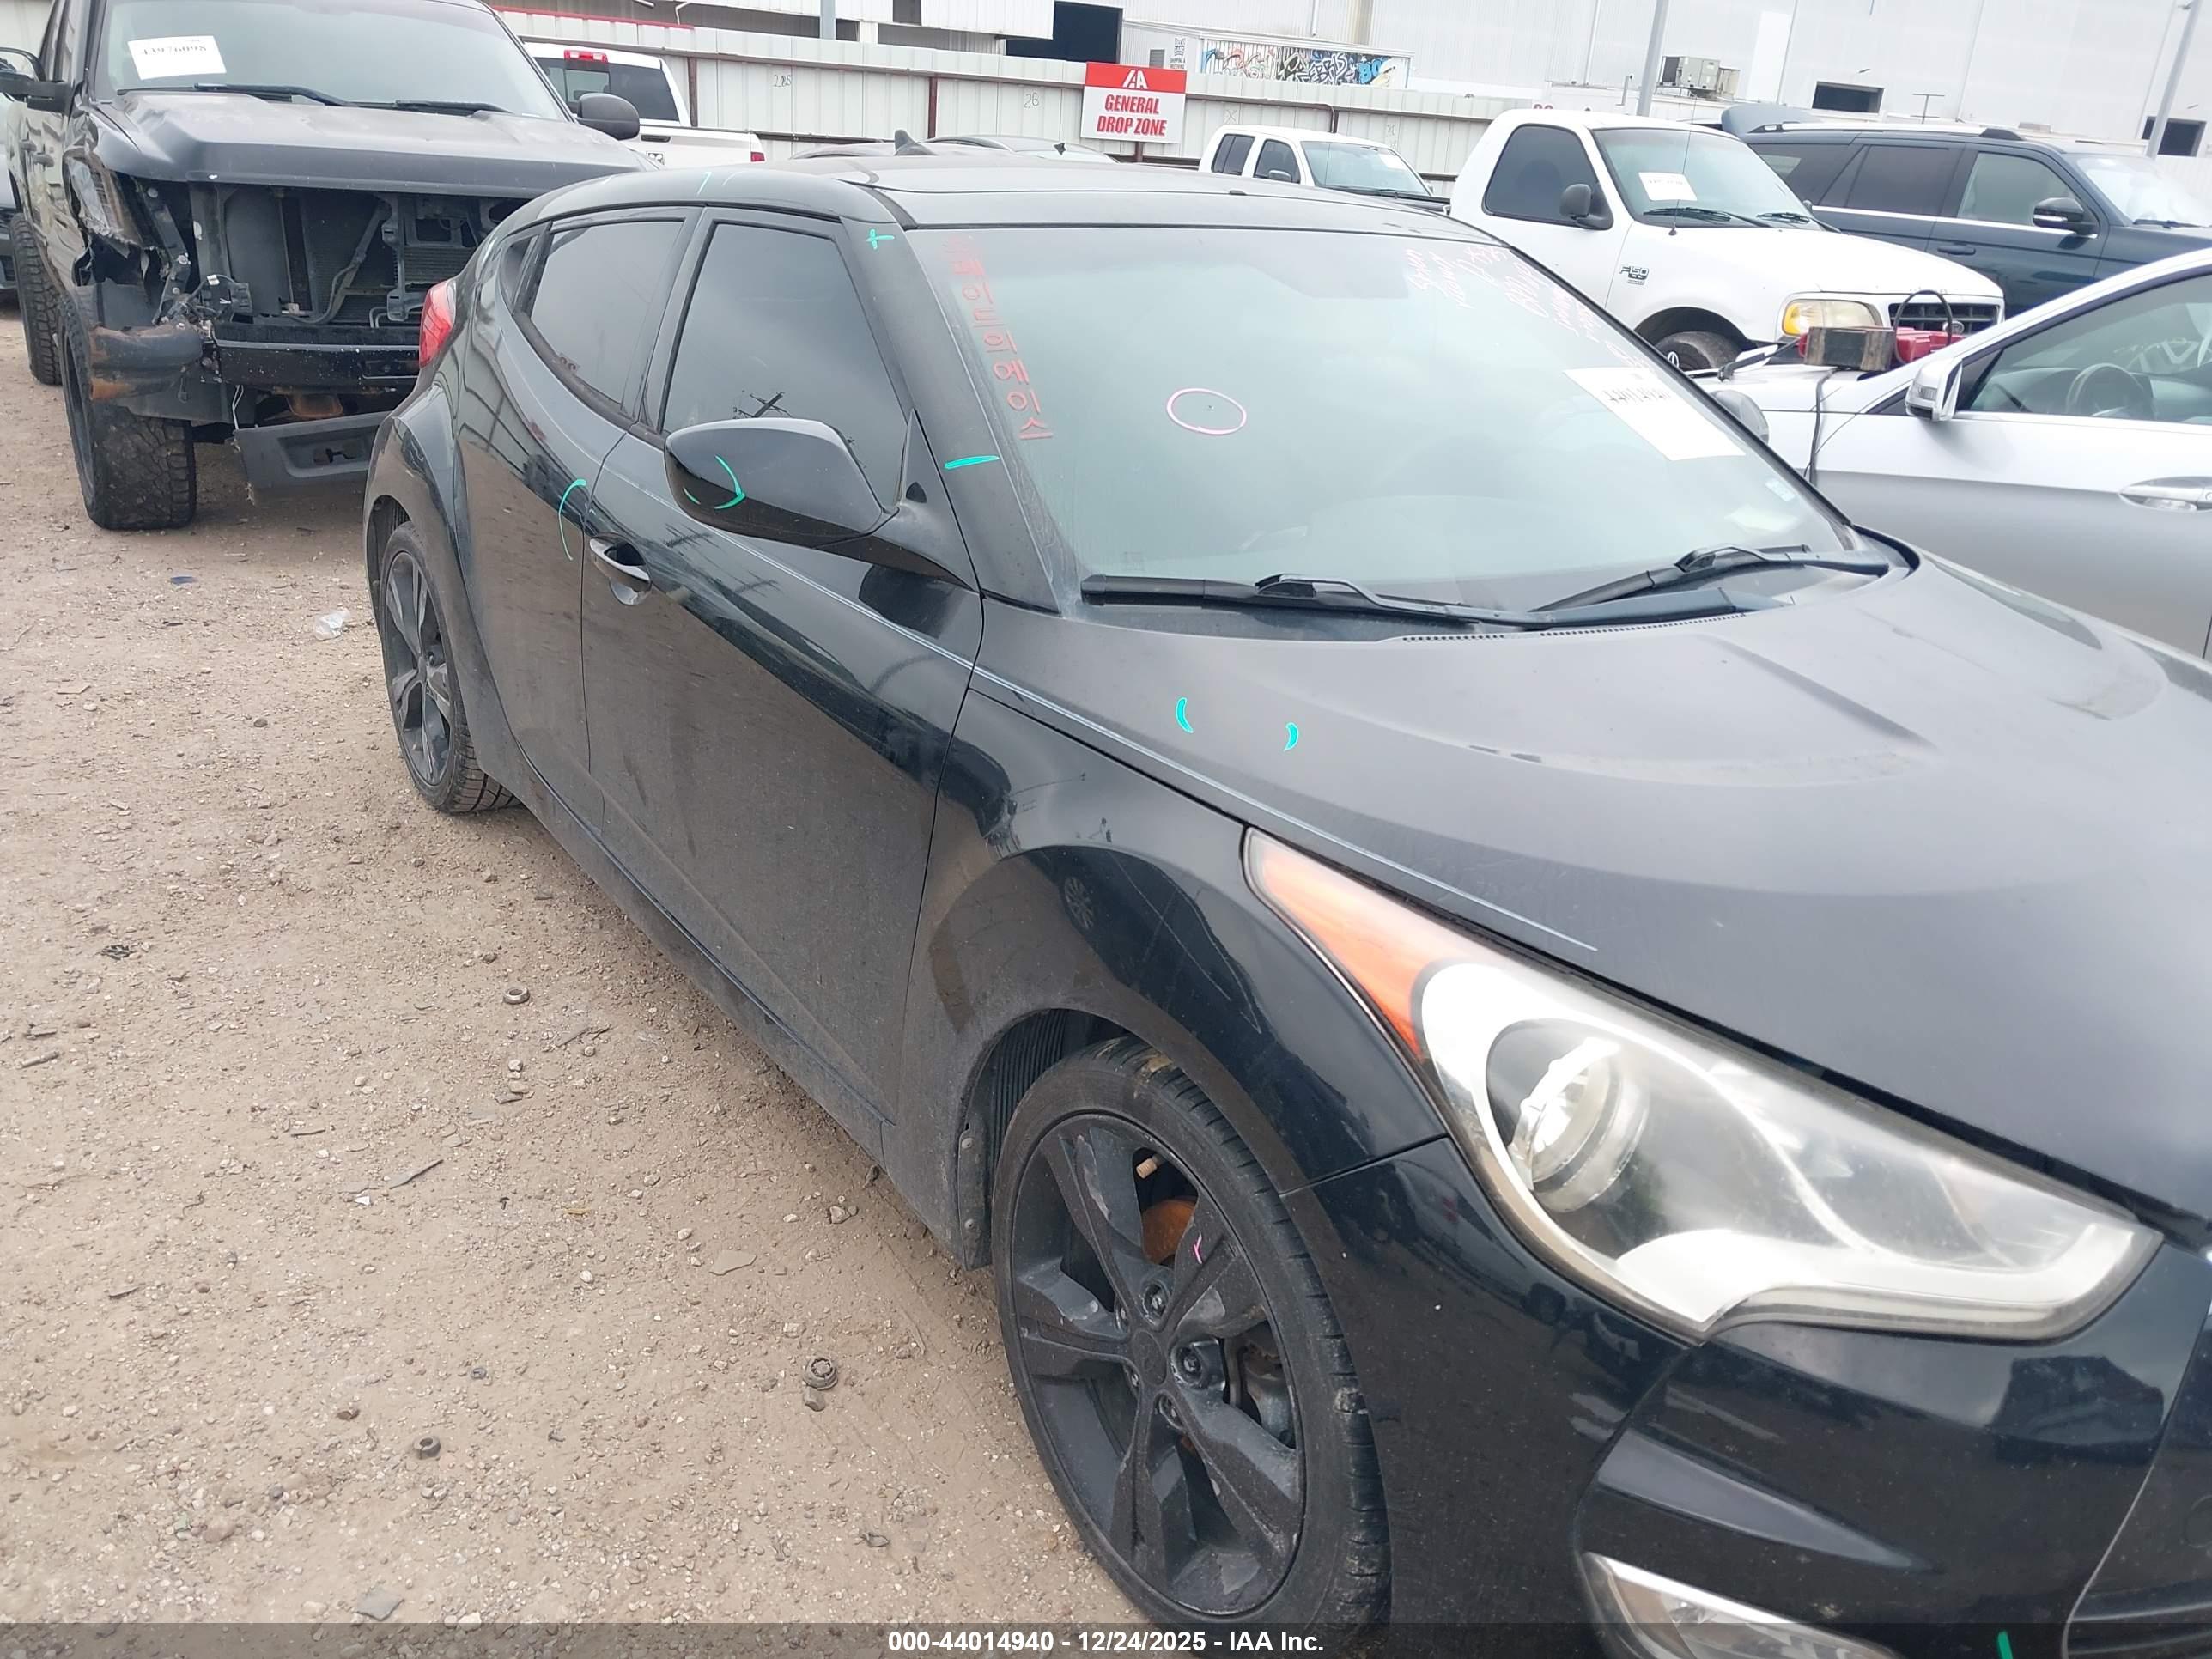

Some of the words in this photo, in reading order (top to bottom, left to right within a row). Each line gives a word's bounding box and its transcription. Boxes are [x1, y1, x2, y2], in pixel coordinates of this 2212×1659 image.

[1104, 94, 1160, 114] GENERAL
[1097, 115, 1133, 134] DROP
[1133, 118, 1167, 136] ZONE
